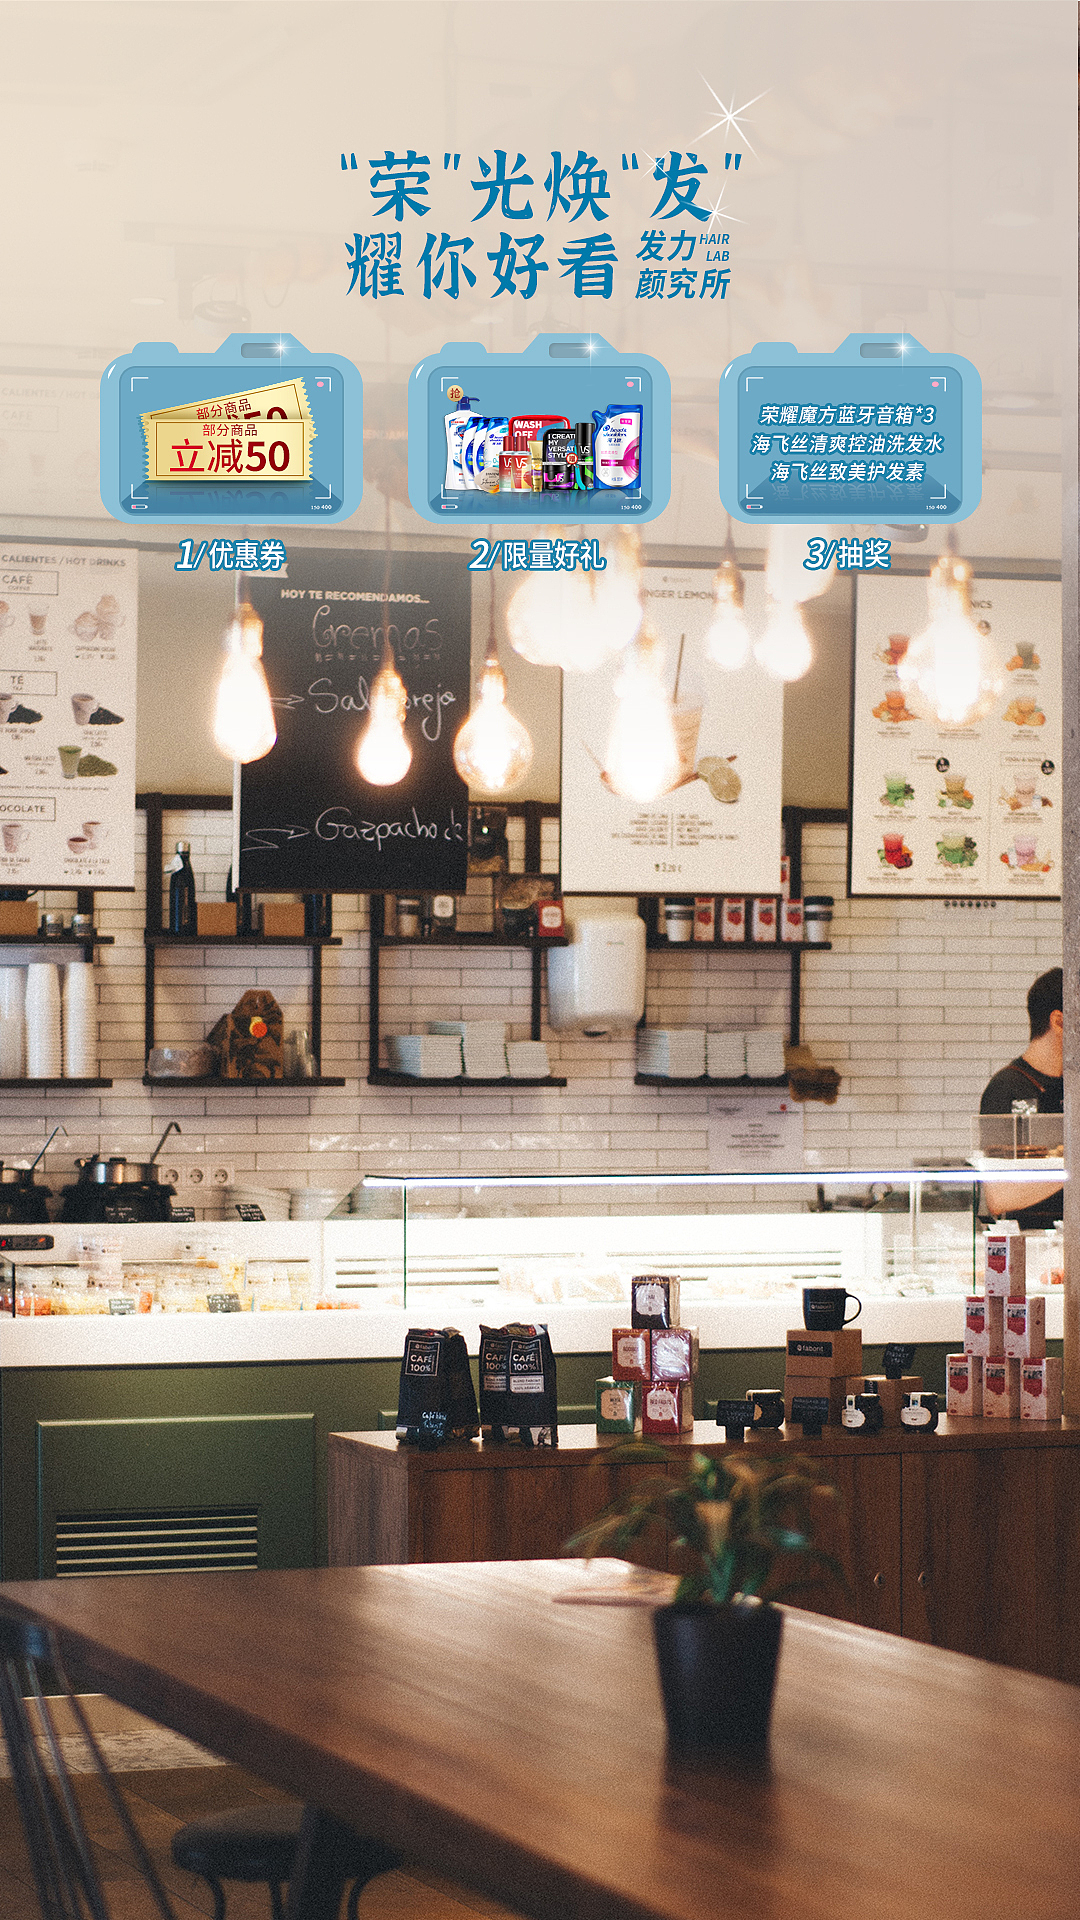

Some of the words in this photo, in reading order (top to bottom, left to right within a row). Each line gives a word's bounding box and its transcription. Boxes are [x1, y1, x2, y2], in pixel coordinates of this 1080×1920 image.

[2, 554, 57, 564] CALIENTES
[66, 557, 86, 566] HOT
[89, 558, 127, 567] DRINKS
[2, 573, 34, 585] CAFÉ
[281, 589, 306, 599] HOY
[308, 590, 324, 600] TE
[315, 806, 438, 851] Gazpacho
[410, 1354, 432, 1363] CAFÉ
[512, 1352, 535, 1362] CAFÉ
[410, 1364, 431, 1373] 100%
[513, 1363, 537, 1371] 100%
